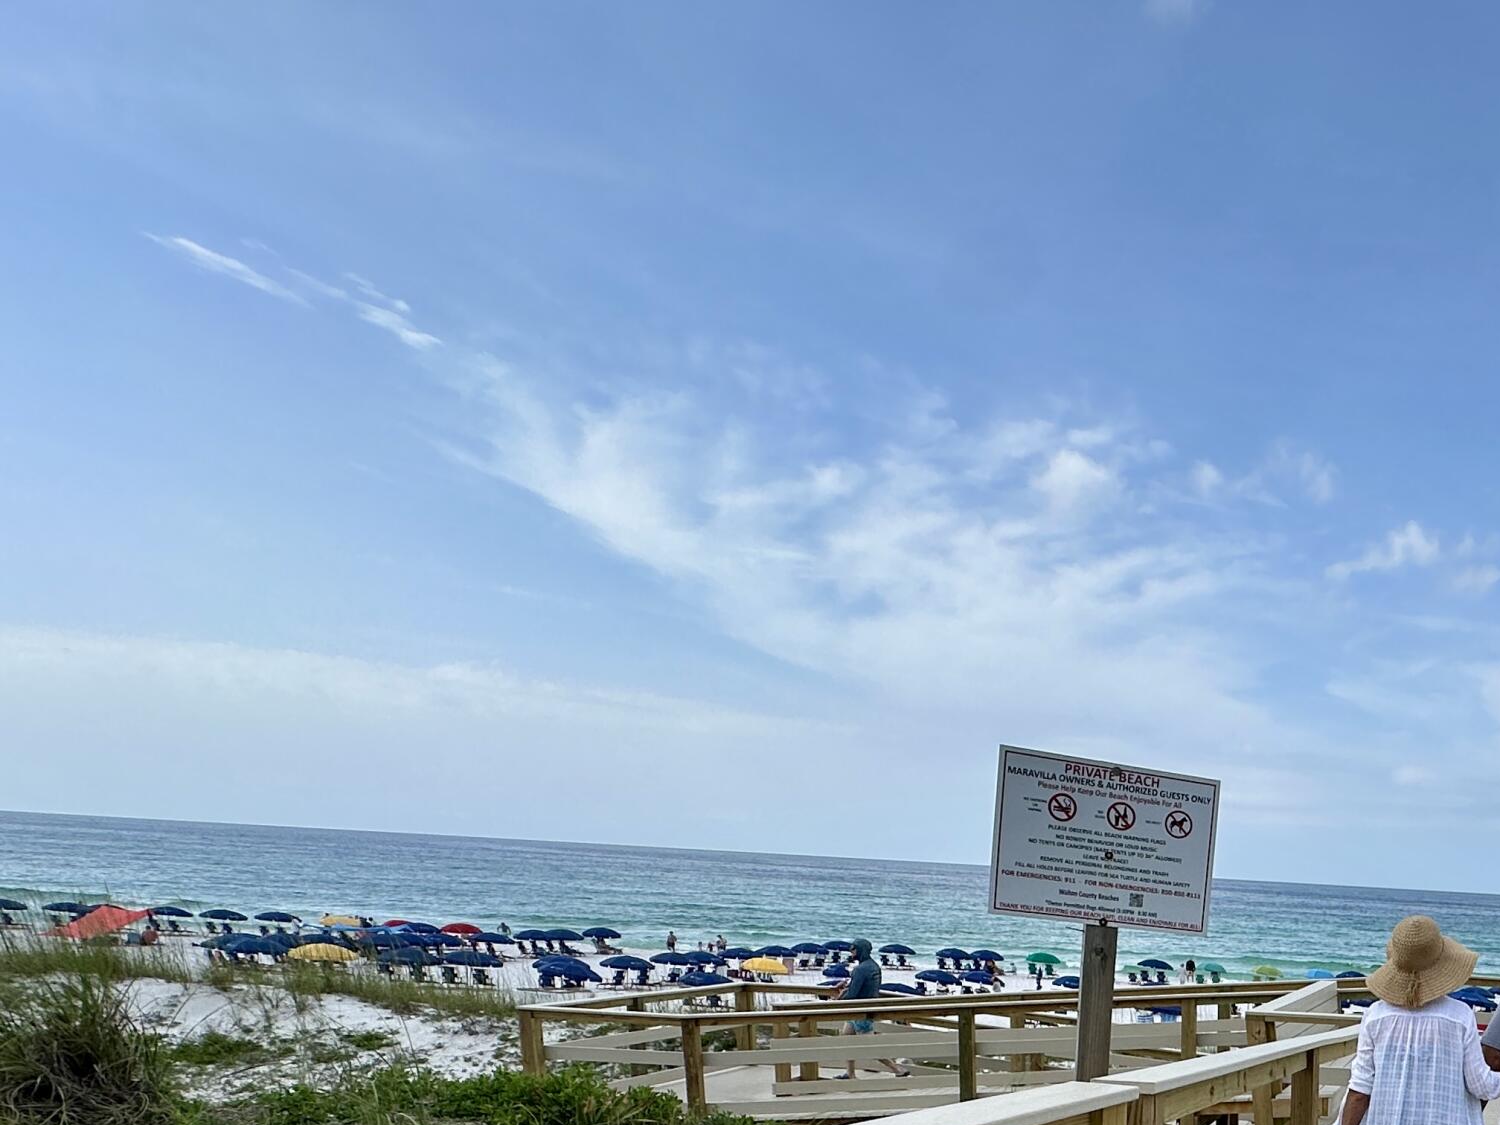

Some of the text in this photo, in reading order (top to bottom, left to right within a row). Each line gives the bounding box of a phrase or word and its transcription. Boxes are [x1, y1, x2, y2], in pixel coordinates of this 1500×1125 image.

[1008, 766, 1056, 781] MARAVILLA
[1059, 774, 1096, 787] OWNERS
[1107, 782, 1158, 797] AUTHORIZED
[1160, 790, 1190, 802] GUESTS
[1191, 795, 1211, 805] ONLY
[1065, 763, 1160, 788] PRIVATE BEACH
[1038, 781, 1059, 790] Please
[1061, 784, 1076, 794] Help
[1078, 787, 1094, 796] Keep
[1109, 792, 1129, 800] Beach
[1130, 795, 1160, 807] Enjoyable
[1048, 824, 1067, 832] PLEASE
[1069, 827, 1093, 835] OBSERVE
[1123, 835, 1149, 843] WARNING
[1079, 891, 1097, 900] County
[1099, 893, 1119, 901] Beaches
